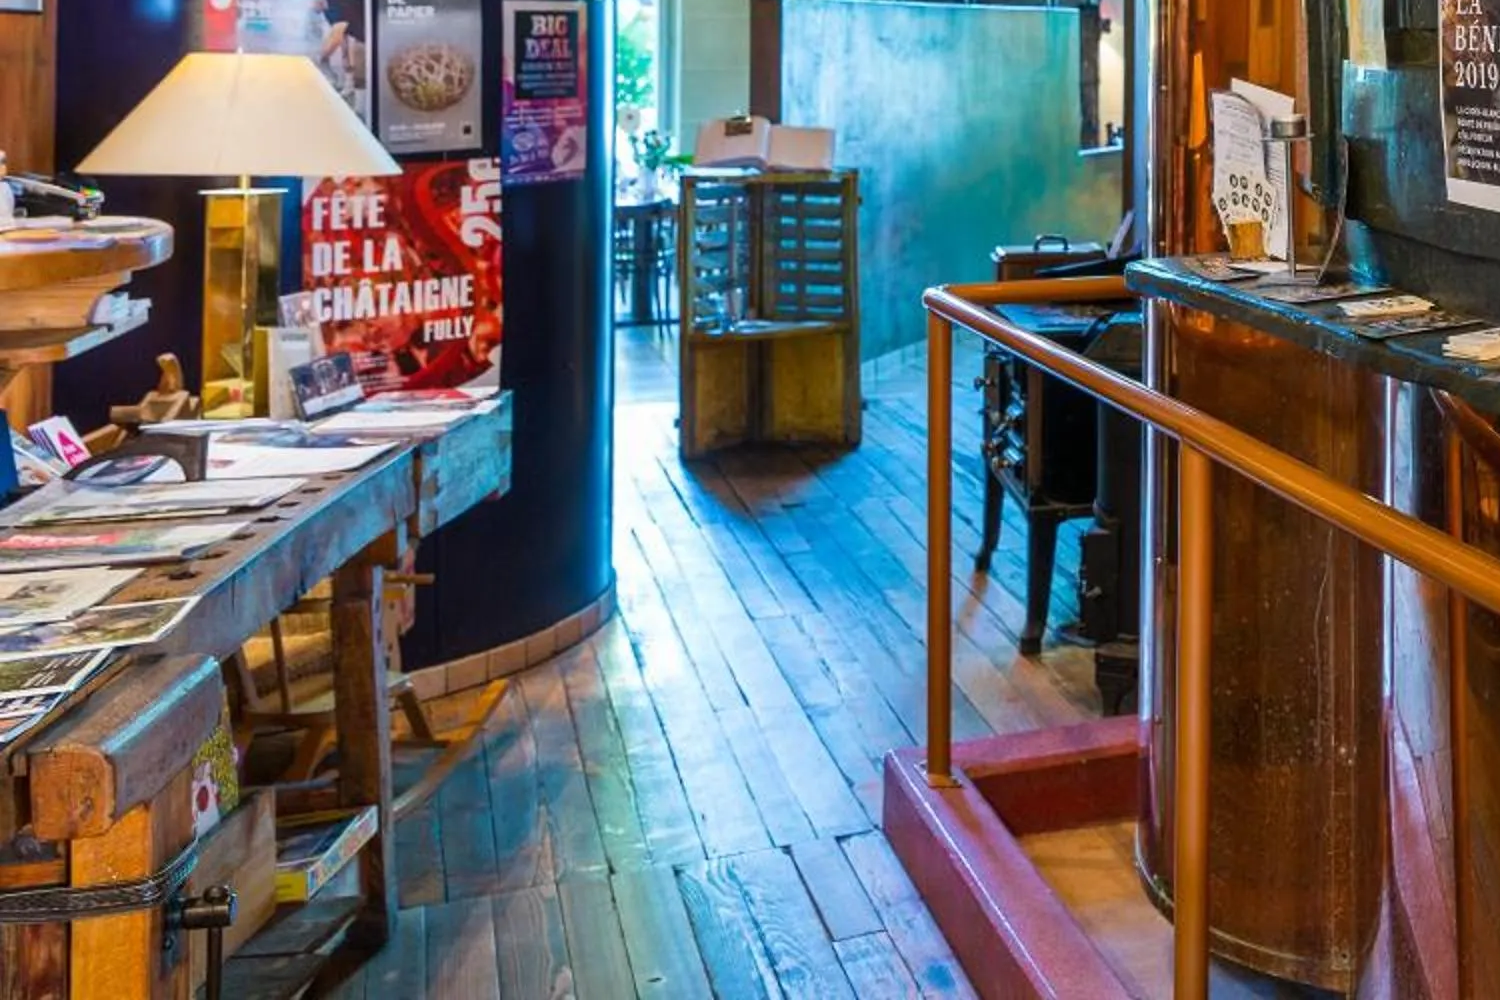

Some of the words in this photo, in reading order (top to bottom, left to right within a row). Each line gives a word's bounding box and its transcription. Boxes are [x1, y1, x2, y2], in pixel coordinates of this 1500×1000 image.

[530, 13, 568, 37] BIG
[524, 37, 573, 60] DEAL
[1454, 60, 1499, 91] 2019
[311, 189, 388, 231] FÊTE
[311, 240, 353, 277] DE
[362, 231, 404, 274] LA
[312, 274, 476, 323] CHÂTAIGNE
[422, 315, 476, 344] FULLY
